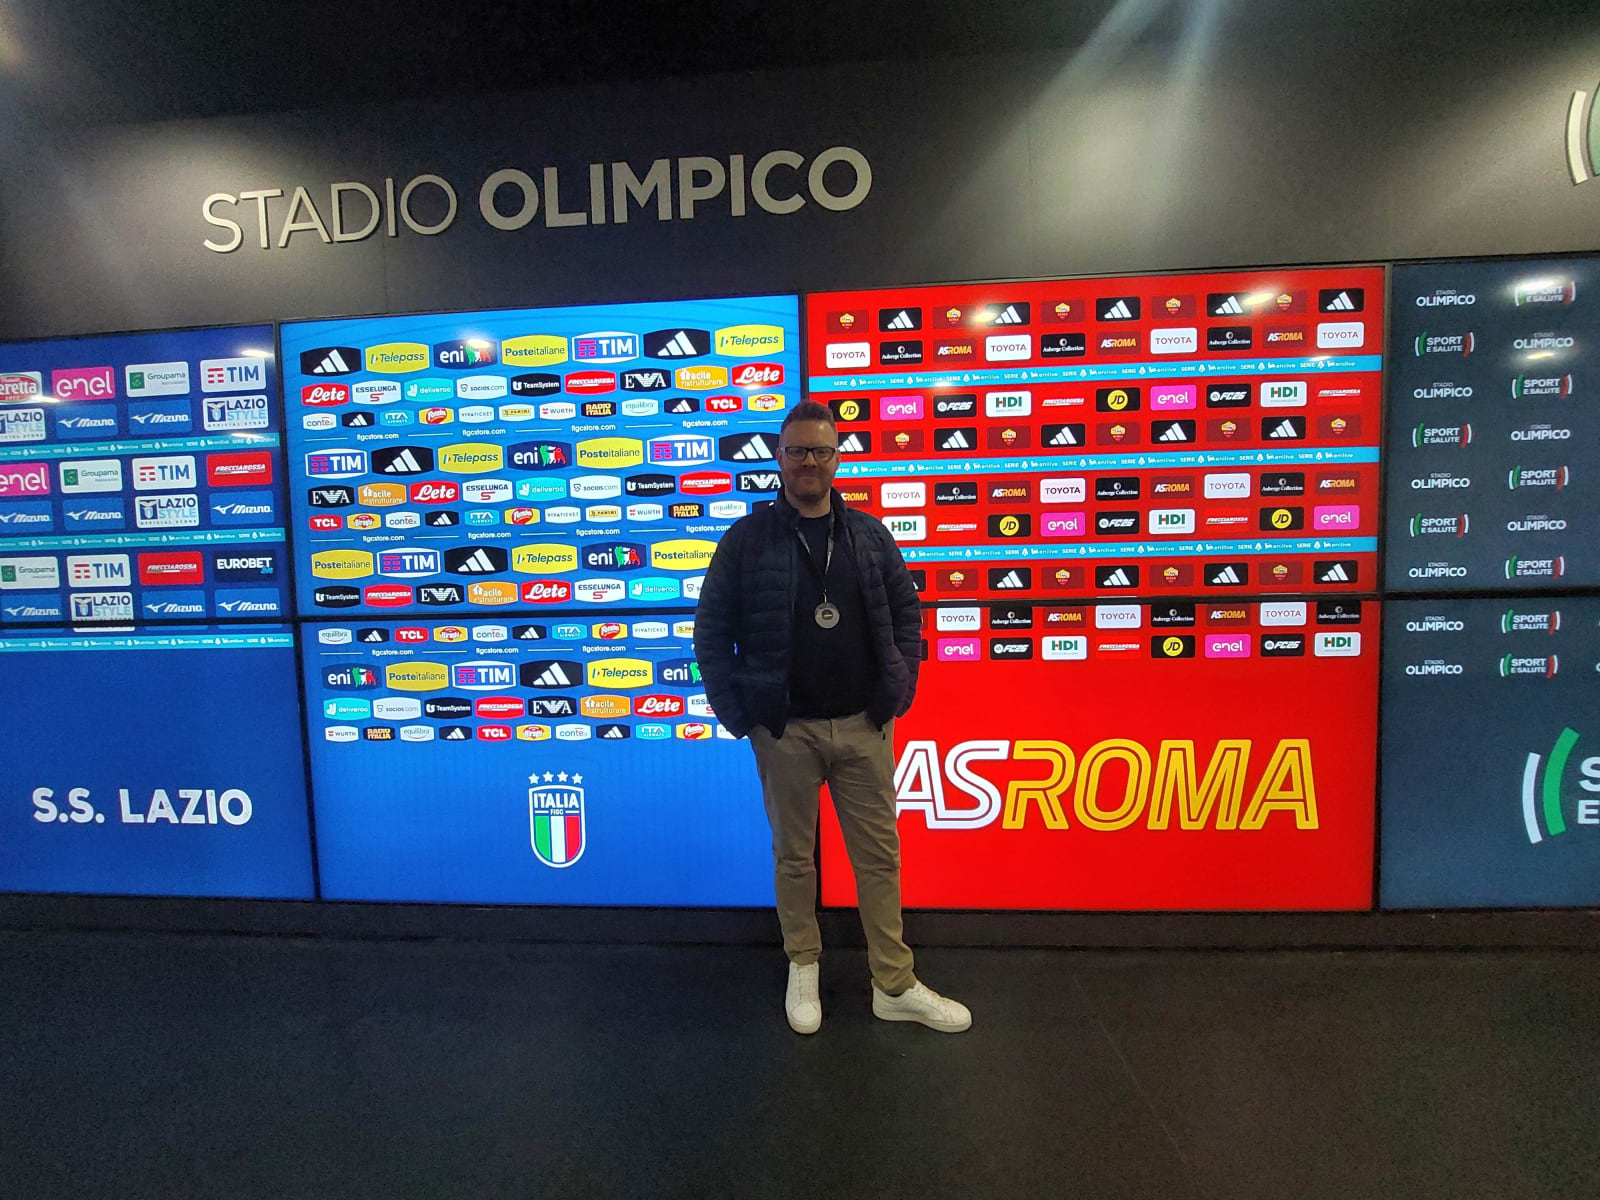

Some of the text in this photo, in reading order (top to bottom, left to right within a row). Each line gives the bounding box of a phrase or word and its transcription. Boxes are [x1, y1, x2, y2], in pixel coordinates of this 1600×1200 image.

[202, 146, 872, 253] STADIO OLIMPICO
[1416, 295, 1475, 307] OLIMPICO
[730, 335, 779, 346] Telepass
[1426, 337, 1462, 345] SPORT
[1514, 337, 1573, 349] OLIMPICO
[599, 338, 632, 355] TIM
[991, 344, 1026, 353] TOYOTA
[380, 352, 424, 363] Telepass
[440, 346, 464, 364] eni
[832, 352, 865, 360] TOYOTA
[227, 366, 259, 382] TIM
[735, 367, 780, 384] Lete
[0, 378, 37, 395] eretta
[56, 371, 112, 398] enel
[1524, 379, 1560, 387] SPORT
[305, 387, 345, 403] Lete
[1158, 391, 1188, 404] enel
[1271, 387, 1297, 397] HDI
[1414, 387, 1472, 398] OLIMPICO
[227, 399, 266, 410] LAZIO
[711, 400, 737, 409] TCL
[887, 401, 916, 415] enel
[995, 397, 1022, 408] HDI
[227, 409, 266, 420] STYLE
[842, 406, 856, 415] JD
[5, 412, 43, 423] LAZIO
[7, 422, 43, 433] STYLE
[1424, 428, 1460, 436] SPORT
[1511, 430, 1570, 440] OLIMPICO
[514, 447, 538, 464] eni
[674, 442, 708, 458] TIM
[330, 456, 362, 471] TIM
[453, 454, 498, 464] Telepass
[158, 464, 189, 480] TIM
[1520, 470, 1557, 478] SPORT
[1411, 478, 1470, 488] OLIMPICO
[414, 485, 455, 500] Lete
[1045, 486, 1080, 495] TOYOTA
[158, 498, 196, 508] LAZIO
[158, 508, 196, 519] STYLE
[1158, 514, 1185, 524] HDI
[1274, 514, 1289, 524] JD
[1321, 511, 1351, 523] enel
[315, 519, 337, 527] TCL
[891, 522, 916, 532] HDI
[1003, 520, 1016, 530] JD
[1048, 518, 1078, 531] enel
[1421, 518, 1457, 526] SPORT
[1507, 520, 1566, 531] OLIMPICO
[402, 555, 434, 570] TIM
[526, 552, 572, 564] Telepass
[588, 549, 612, 565] eni
[217, 558, 272, 570] EUROBET
[1517, 560, 1553, 568] SPORT
[92, 562, 124, 578] TIM
[1408, 567, 1467, 577] OLIMPICO
[525, 584, 568, 600] Lete
[93, 596, 130, 606] LAZIO
[1513, 615, 1549, 623] SPORT
[1406, 621, 1464, 631] OLIMPICO
[400, 631, 423, 640] TCL
[1052, 640, 1078, 650] HDI
[1212, 640, 1242, 652] enel
[1324, 637, 1351, 648] HDI
[478, 668, 509, 683] TIM
[602, 668, 648, 678] Telepass
[663, 664, 688, 681] eni
[1406, 665, 1463, 675] OLIMPICO
[328, 669, 350, 685] eni
[638, 698, 680, 712] Lete
[482, 728, 507, 738] TCL
[533, 792, 580, 808] ITALIA
[32, 787, 252, 826] S.S. LAZIO
[1578, 800, 1600, 824] E
